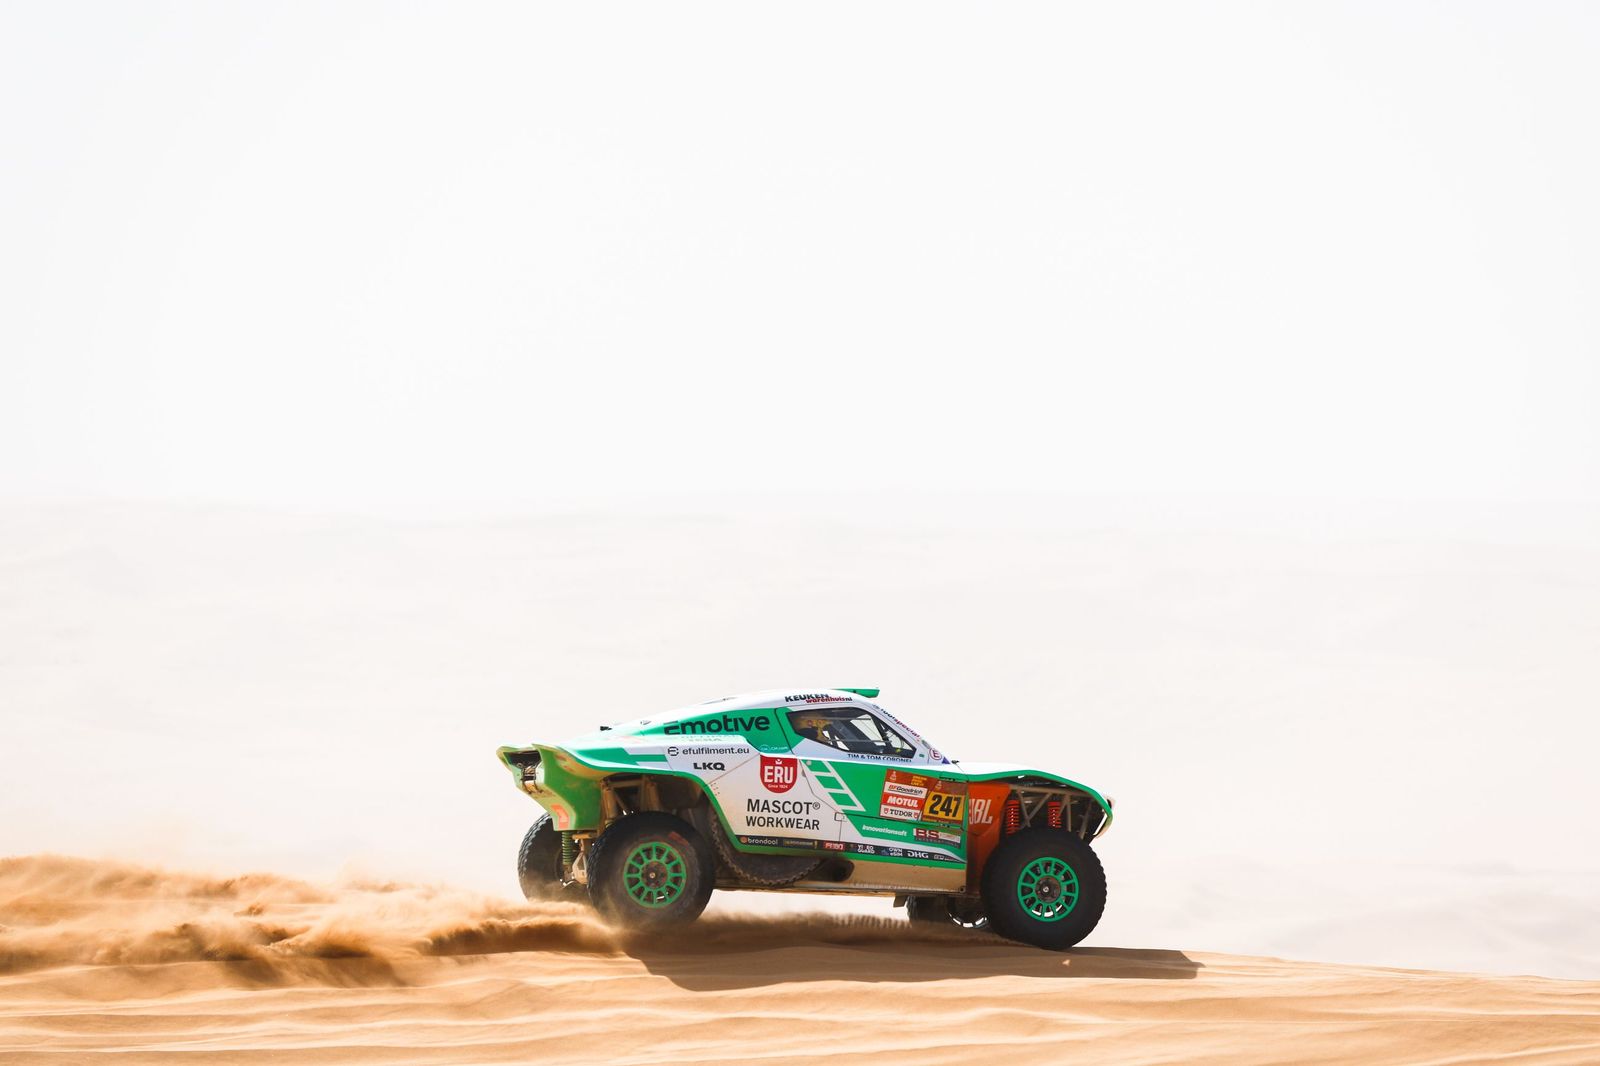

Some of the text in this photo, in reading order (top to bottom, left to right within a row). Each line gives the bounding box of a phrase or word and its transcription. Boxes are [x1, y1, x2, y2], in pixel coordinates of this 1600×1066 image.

[785, 694, 829, 702] KEUKEN
[663, 714, 770, 735] Emotive
[682, 747, 750, 755] efulfilment.eu
[693, 762, 726, 770] LKQ
[764, 765, 794, 784] ERU
[887, 796, 919, 808] MOTUL
[929, 794, 962, 817] 247
[890, 808, 913, 817] TUDOR
[746, 815, 820, 830] WORKWEAR
[907, 851, 929, 859] DHG
